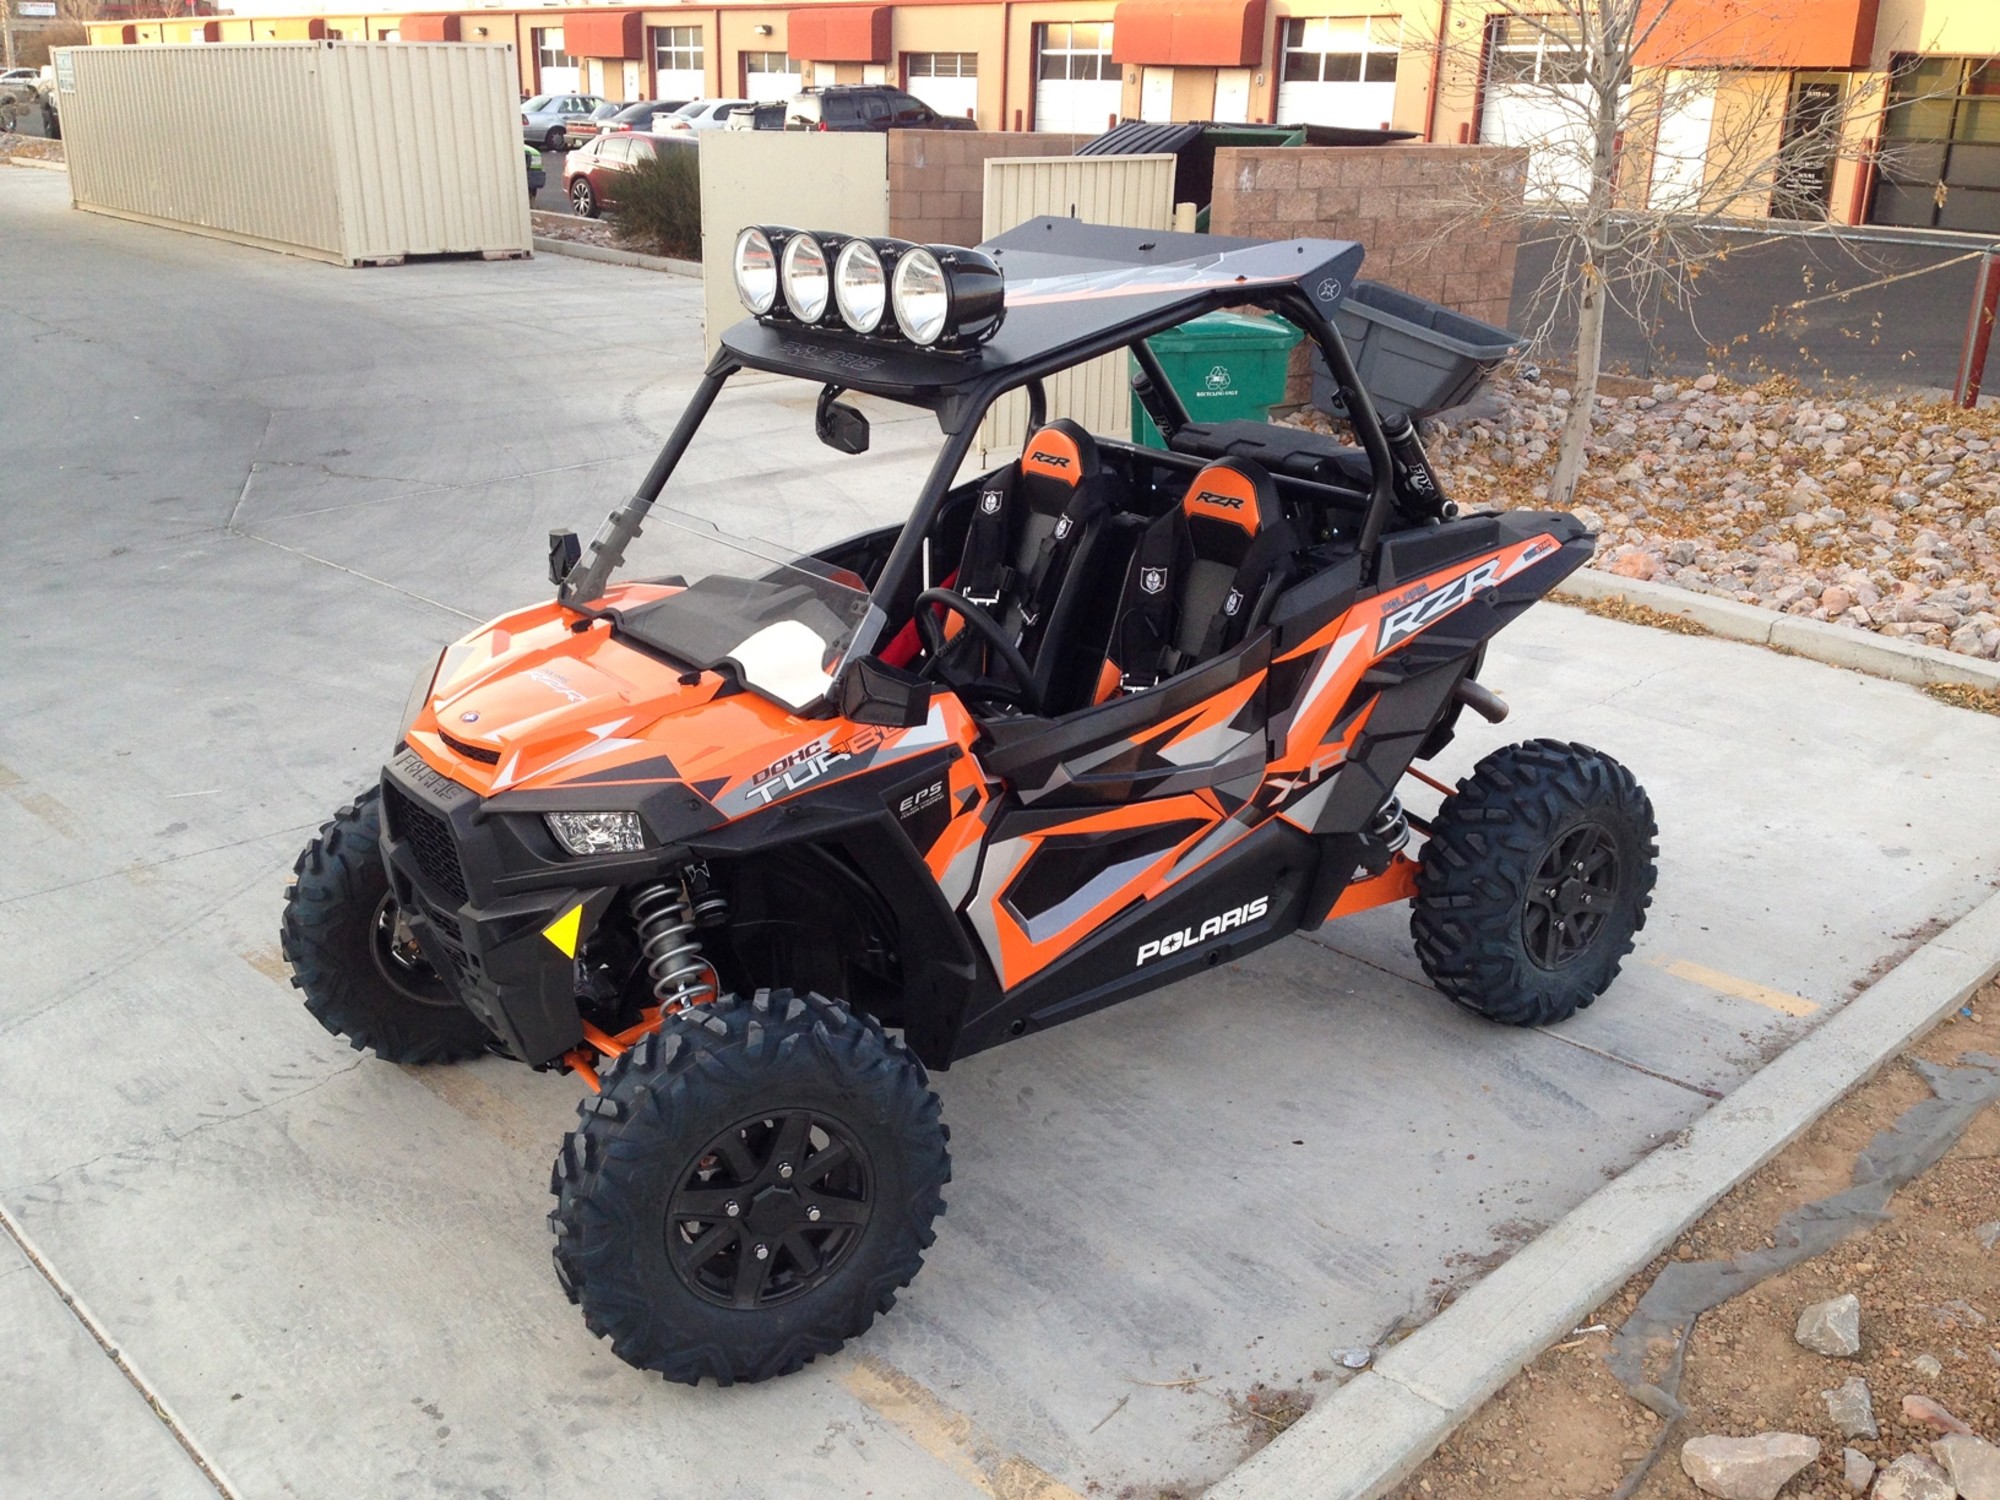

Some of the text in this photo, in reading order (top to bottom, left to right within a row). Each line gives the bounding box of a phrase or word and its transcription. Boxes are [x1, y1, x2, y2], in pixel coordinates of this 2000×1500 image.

[1031, 451, 1071, 468] RZR
[1195, 491, 1245, 510] RZR
[1376, 558, 1500, 654] RZR
[1380, 583, 1430, 614] POLARIS
[395, 754, 465, 800] POLARIS
[752, 740, 822, 786] DOHC
[899, 780, 943, 812] EPS
[1136, 895, 1269, 967] POLARIS
